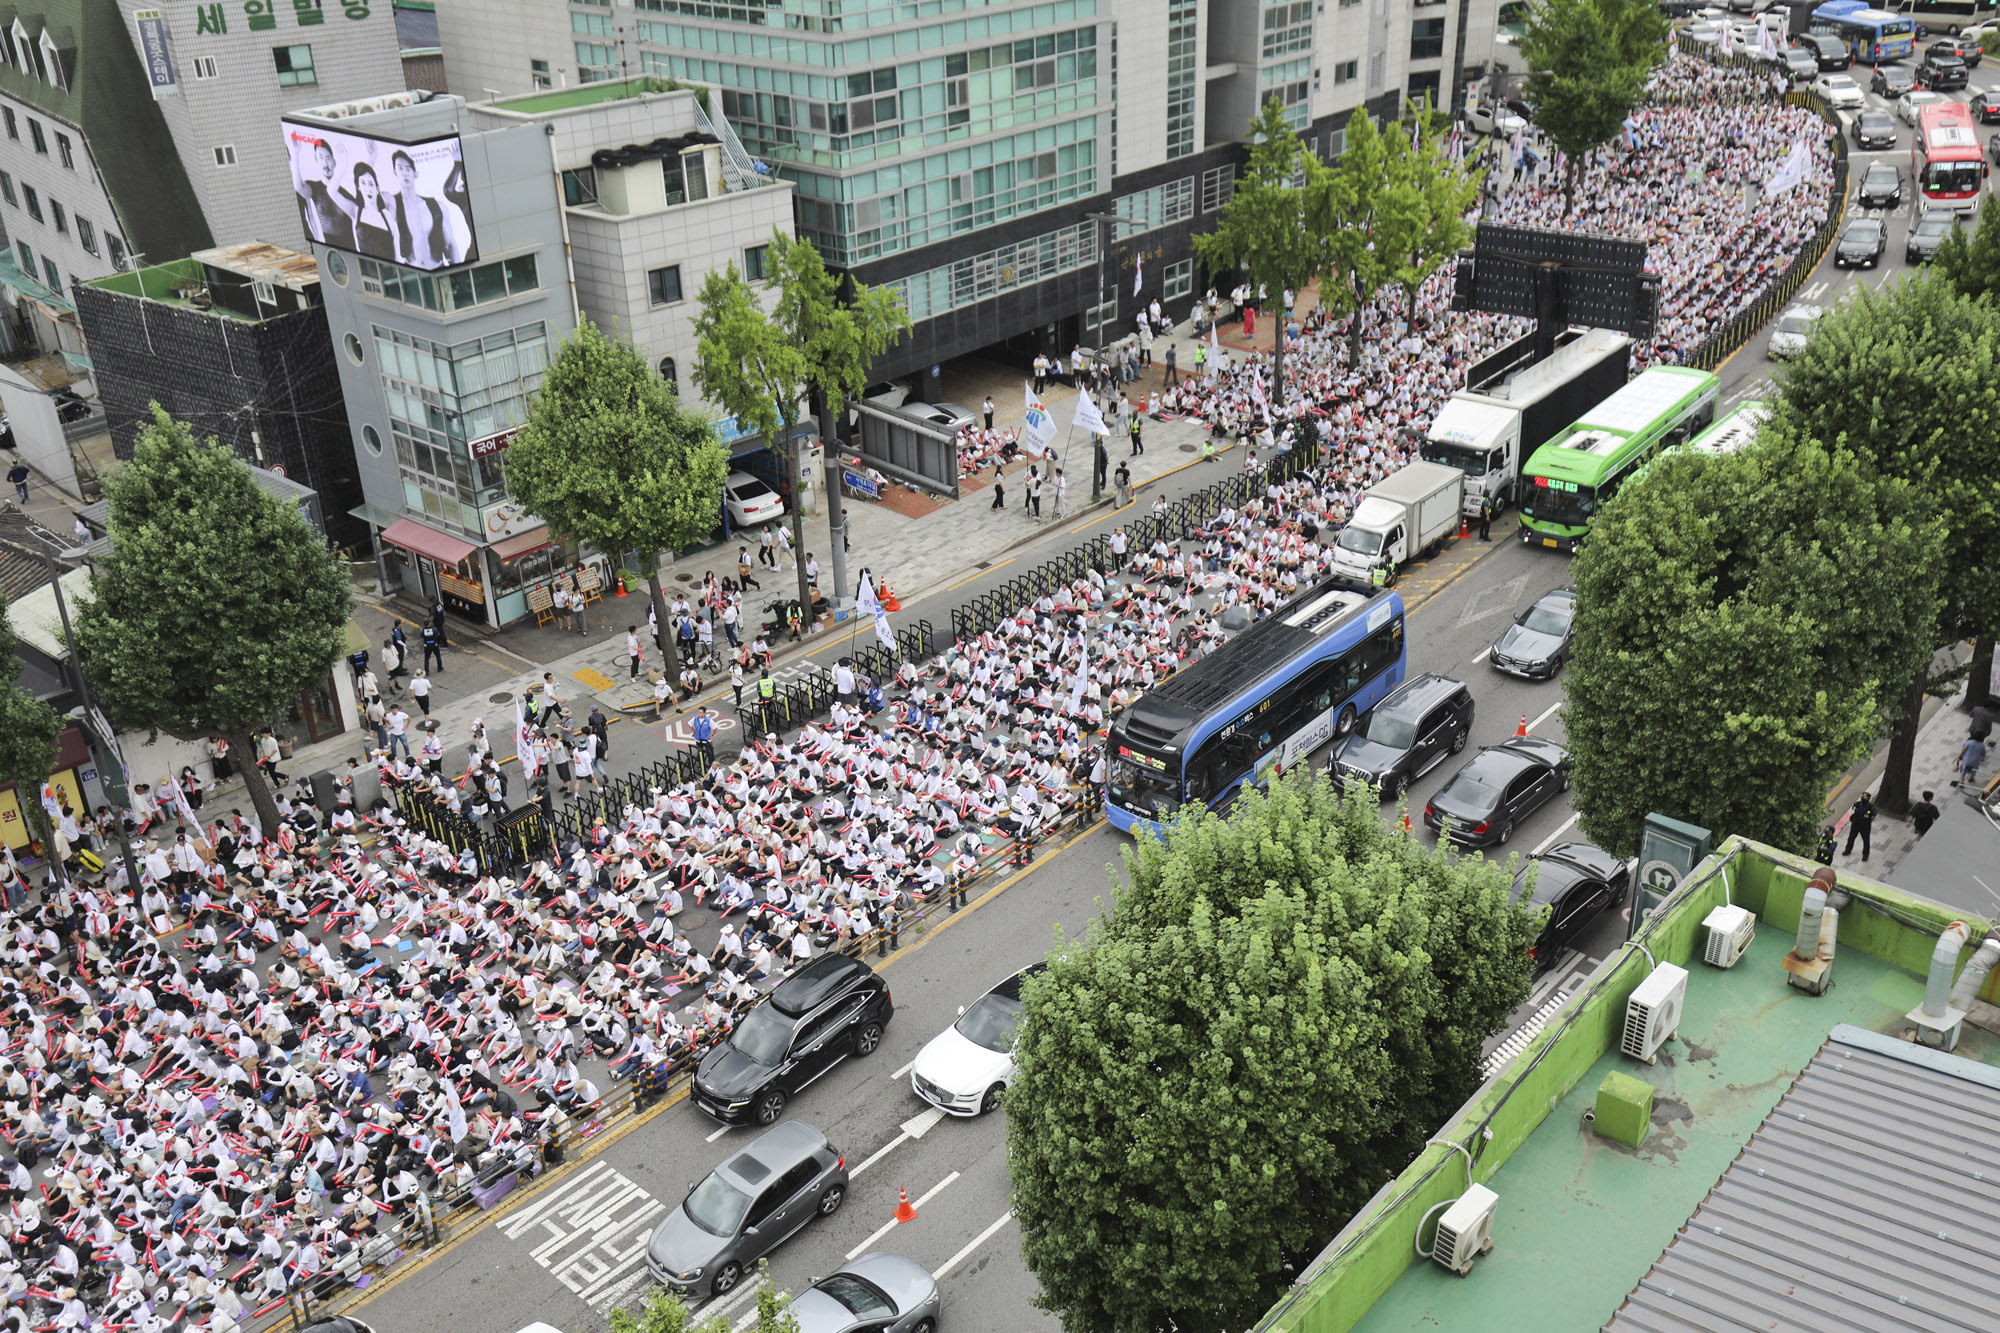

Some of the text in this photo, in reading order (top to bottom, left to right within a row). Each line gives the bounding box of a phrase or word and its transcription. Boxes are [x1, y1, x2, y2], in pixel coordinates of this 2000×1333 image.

[476, 438, 497, 454] 국어
[1260, 699, 1271, 713] 601
[1221, 711, 1255, 741] 친환경 수소버스
[84, 773, 96, 781] 106
[2, 809, 18, 824] 원
